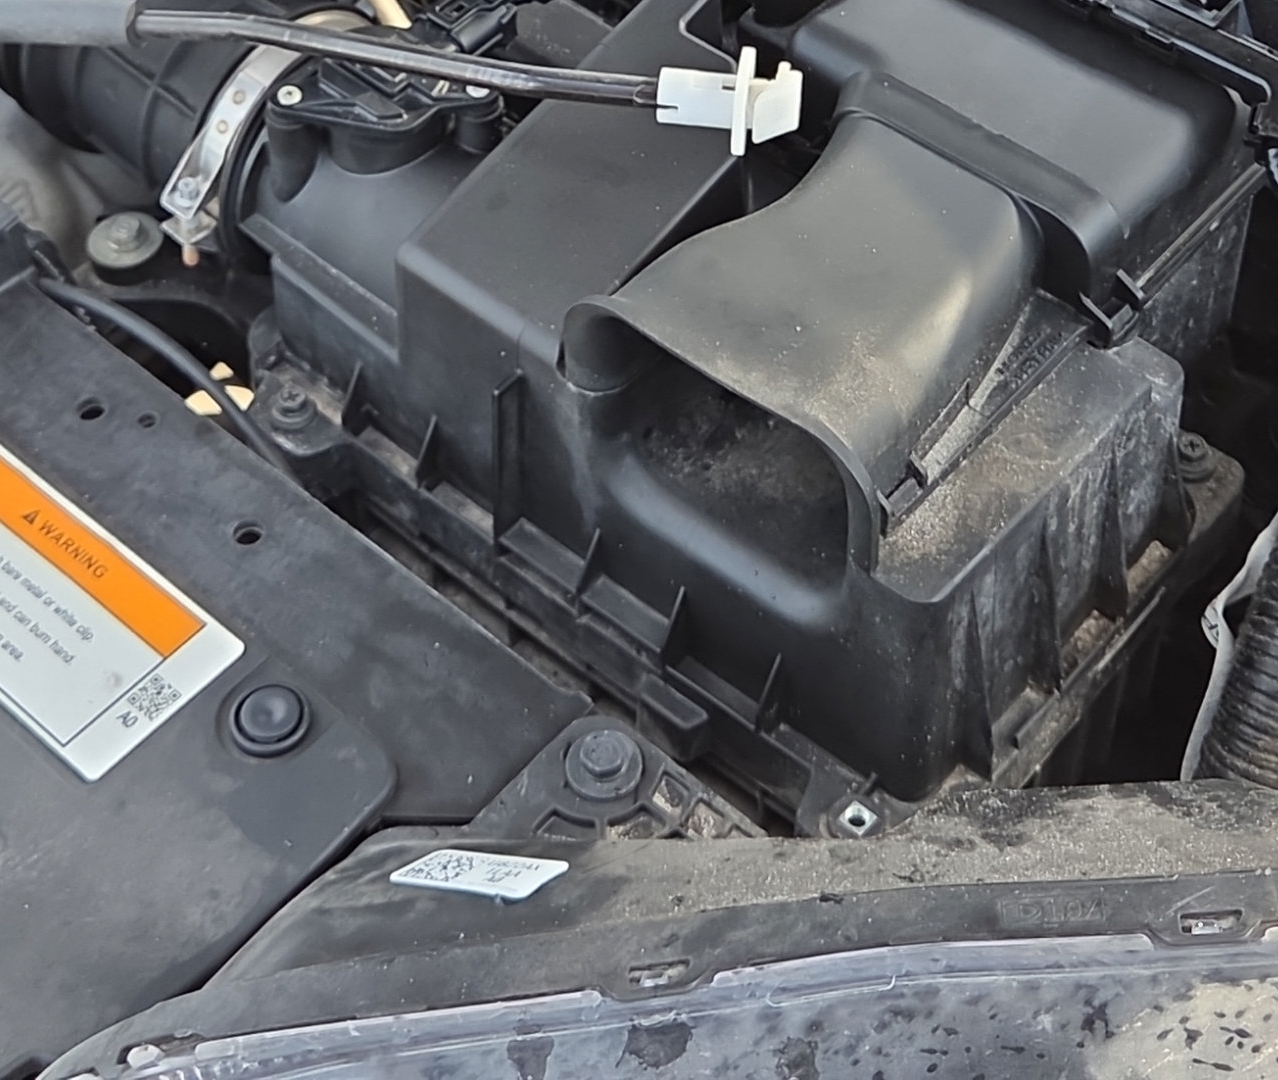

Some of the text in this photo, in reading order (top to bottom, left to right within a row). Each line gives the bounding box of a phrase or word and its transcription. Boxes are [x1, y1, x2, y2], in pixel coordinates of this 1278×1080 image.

[35, 518, 110, 580] WARNING
[0, 560, 24, 581] bare
[17, 575, 47, 600] metal
[40, 594, 57, 608] or
[10, 608, 33, 628] can
[26, 621, 53, 645] burn
